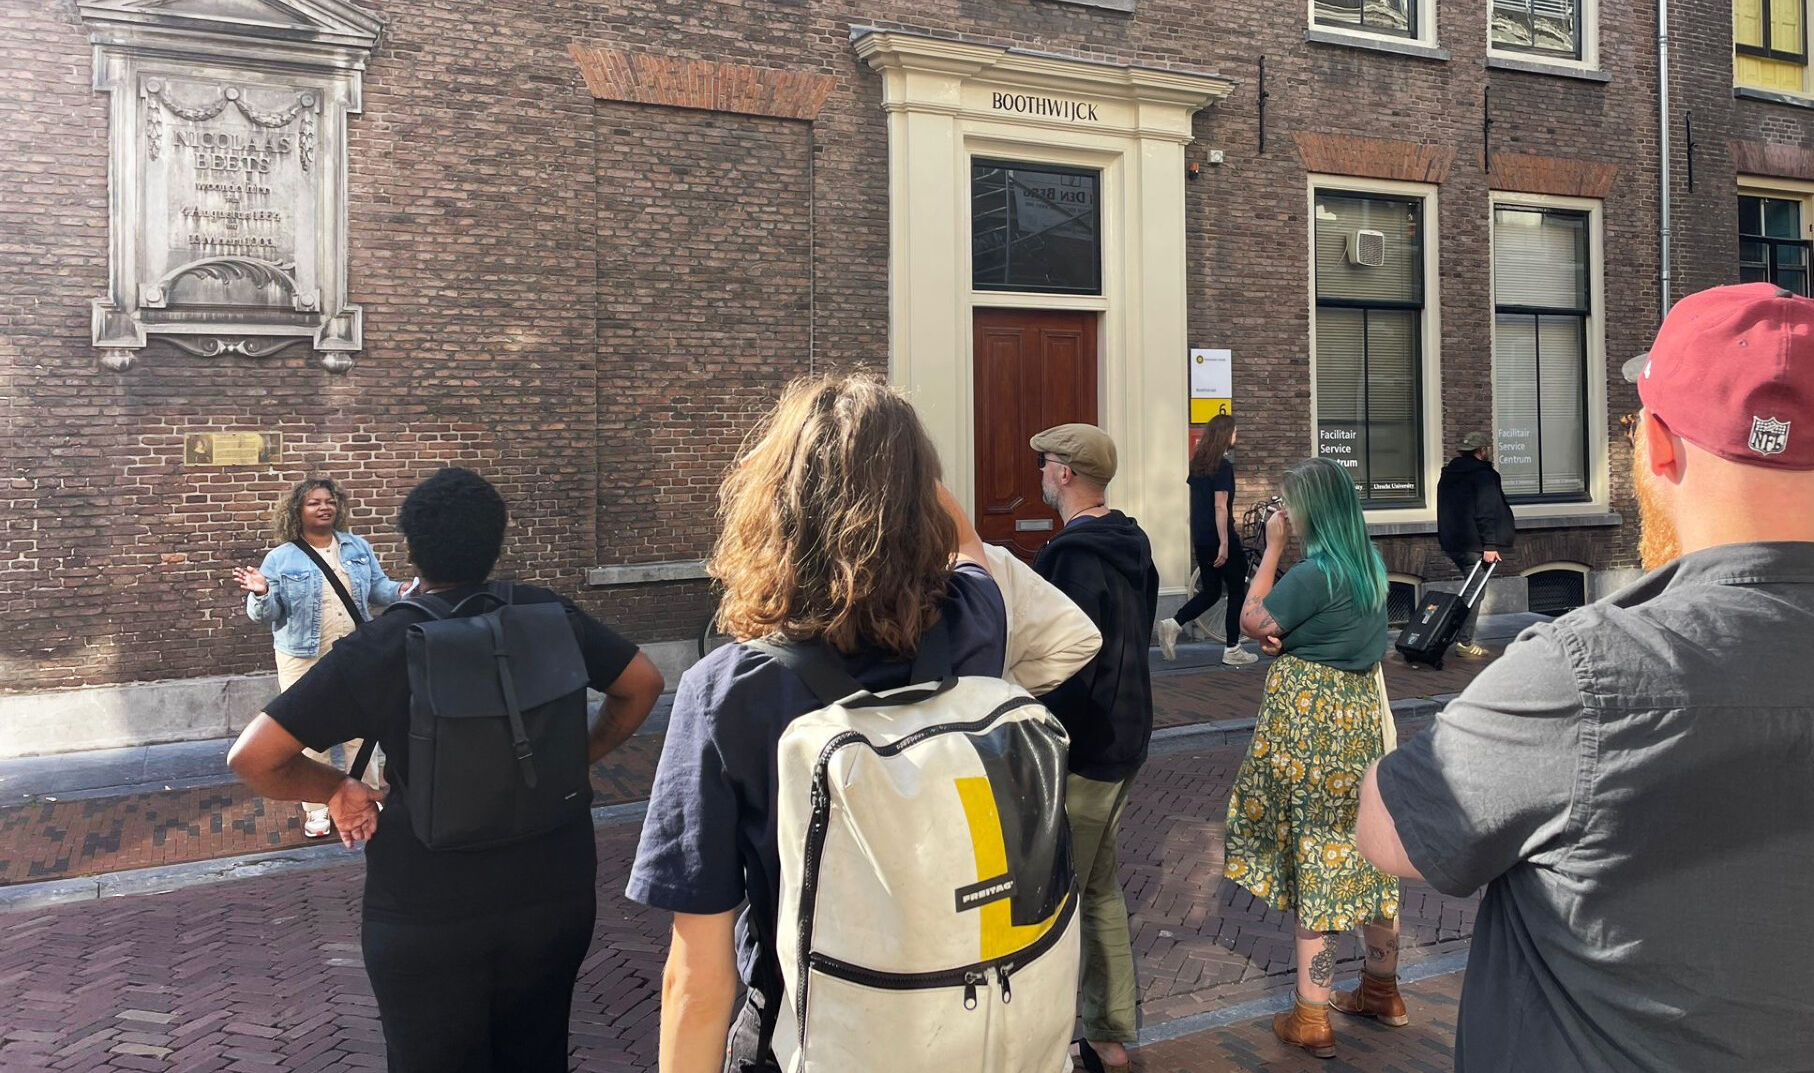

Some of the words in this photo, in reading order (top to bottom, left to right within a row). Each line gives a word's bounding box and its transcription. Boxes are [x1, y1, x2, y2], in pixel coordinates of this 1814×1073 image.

[992, 92, 1098, 121] BOOTHWIJCK
[173, 129, 291, 153] NICOLAAS
[194, 152, 272, 174] BEETS
[1219, 403, 1227, 416] 6
[1320, 429, 1357, 440] Facilitair
[1498, 428, 1530, 438] Facilitair
[1498, 442, 1526, 451] Service
[1751, 432, 1786, 452] NFL
[1320, 444, 1352, 454] Service
[1499, 454, 1532, 464] Centrum
[962, 882, 1012, 904] FREITAG
